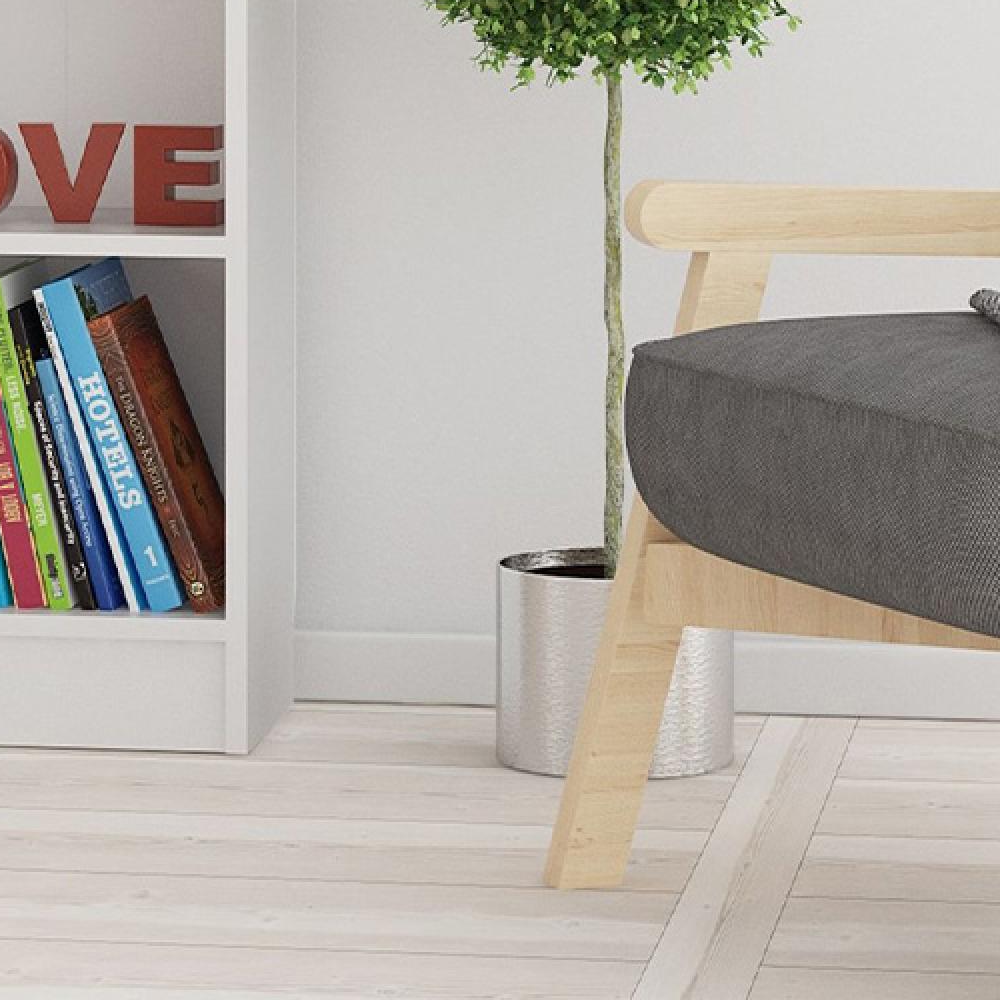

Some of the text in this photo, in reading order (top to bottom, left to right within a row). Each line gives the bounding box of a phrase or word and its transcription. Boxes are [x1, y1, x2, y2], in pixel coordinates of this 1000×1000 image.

[6, 376, 19, 399] LESS
[77, 372, 142, 510] HOTELS
[120, 393, 147, 446] DRAGON
[141, 448, 168, 503] KNIGHTS
[44, 444, 59, 481] Security
[54, 483, 64, 499] and
[32, 493, 45, 526] MEYER
[144, 545, 157, 566] 1
